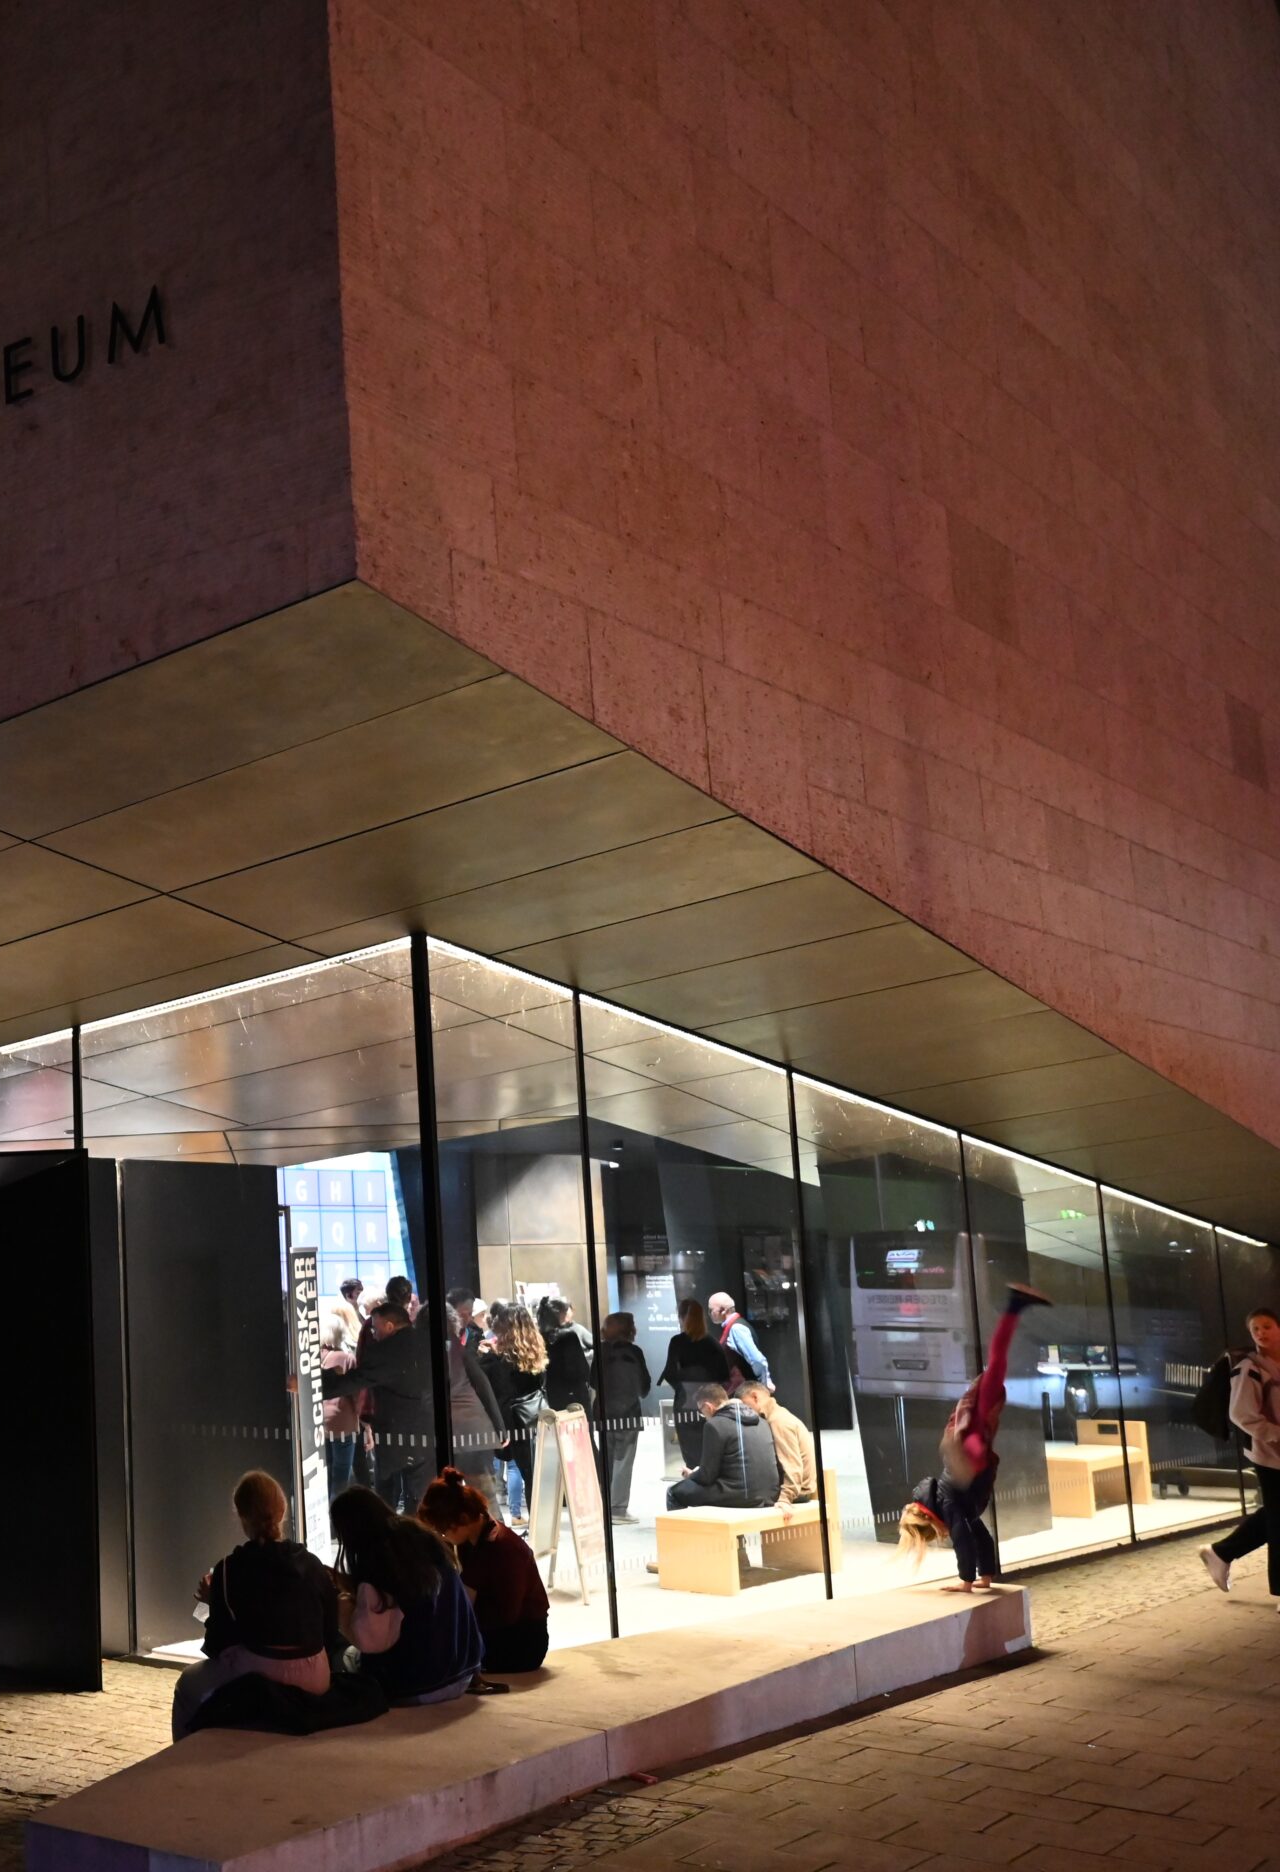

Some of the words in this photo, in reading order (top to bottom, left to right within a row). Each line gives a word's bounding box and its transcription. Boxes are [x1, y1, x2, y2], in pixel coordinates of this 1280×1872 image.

[296, 1180, 308, 1202] G
[330, 1180, 342, 1202] H
[366, 1181, 374, 1202] I
[297, 1221, 308, 1244] P
[331, 1221, 345, 1247] Q
[365, 1221, 377, 1244] R
[294, 1257, 311, 1375] OSKAR
[304, 1255, 325, 1447] SCHINDLER
